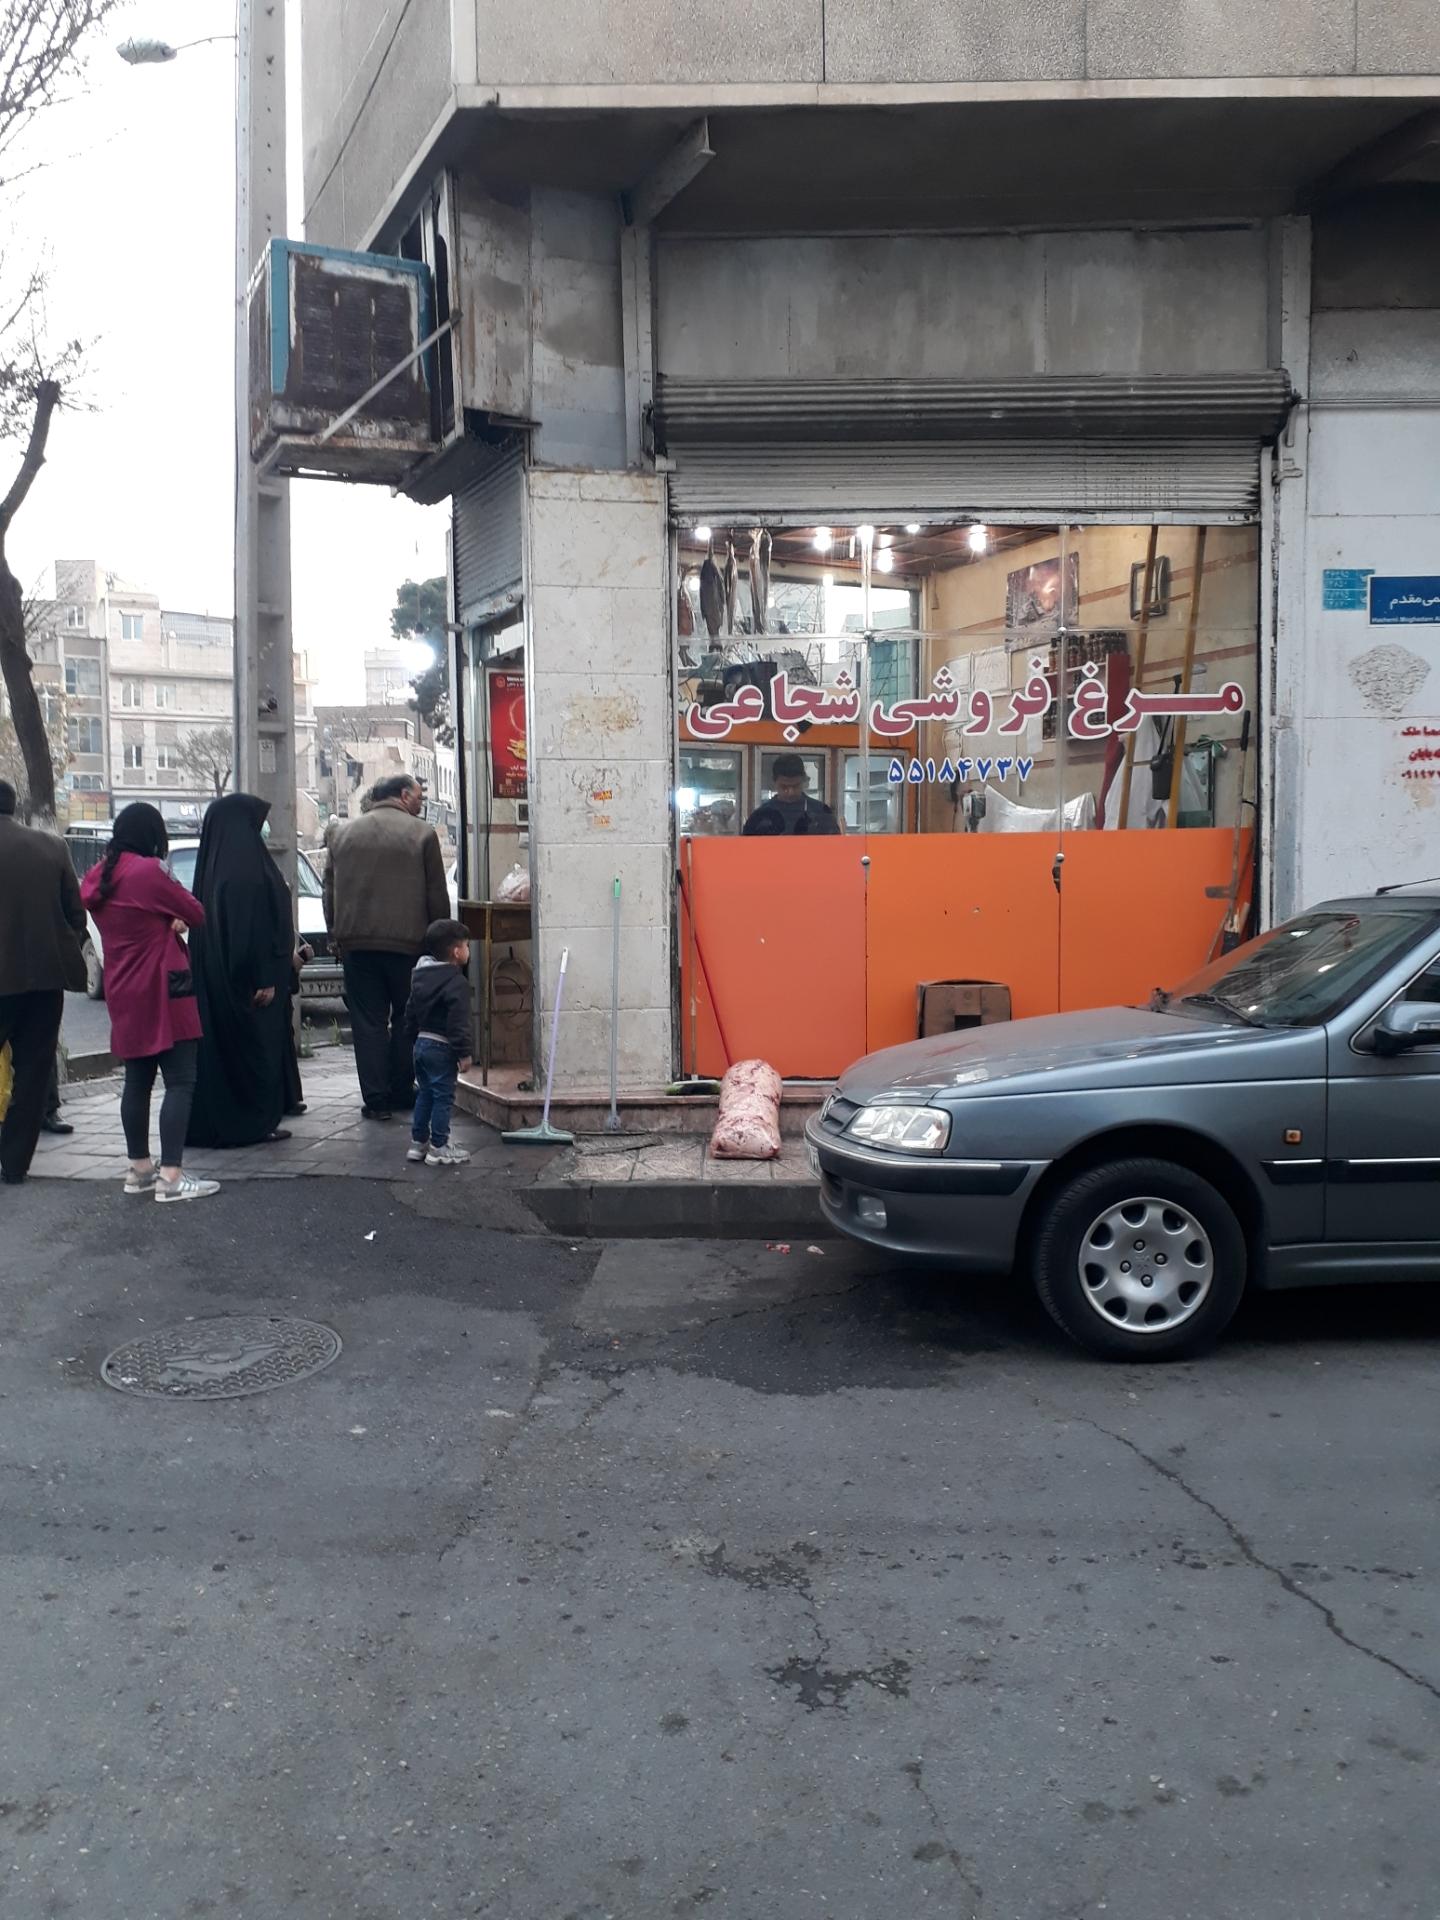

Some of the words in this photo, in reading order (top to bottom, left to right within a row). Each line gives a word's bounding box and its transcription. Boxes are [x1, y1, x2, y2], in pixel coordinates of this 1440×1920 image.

[686, 668, 862, 743] شجاعی
[868, 657, 1052, 738] فروشی
[1068, 662, 1246, 740] مرغ
[887, 756, 1034, 783] ۵۵۱۸۴۷۳۷
